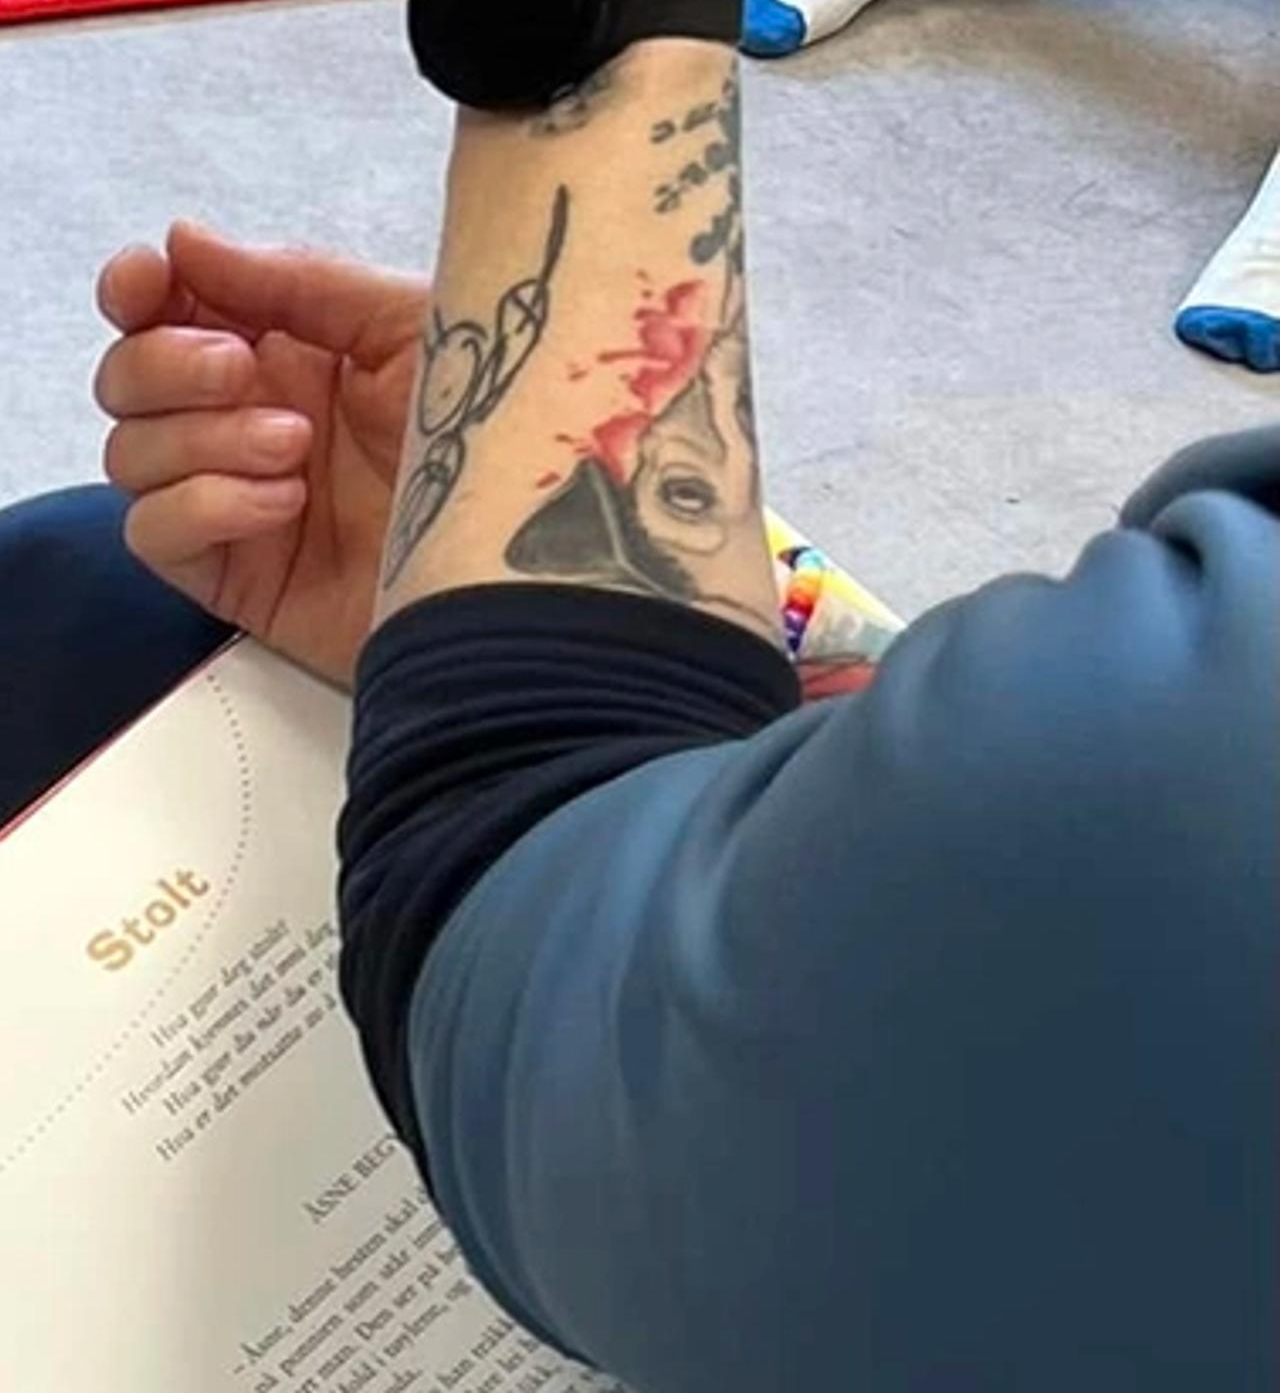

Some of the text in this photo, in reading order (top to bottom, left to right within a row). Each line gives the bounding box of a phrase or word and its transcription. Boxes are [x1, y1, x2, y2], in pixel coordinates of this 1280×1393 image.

[86, 868, 210, 972] Stolt
[121, 1050, 193, 1114] Hvordan
[250, 972, 276, 1000] det
[151, 1013, 188, 1047] Hva
[162, 1082, 201, 1115] Hva
[307, 968, 323, 987] er
[156, 1127, 195, 1161] Hva
[196, 1109, 212, 1130] er
[212, 1083, 240, 1112] det
[303, 1172, 360, 1224] ÅSNE
[279, 1314, 344, 1377] ponnien
[343, 1281, 380, 1313] som
[379, 1248, 411, 1280] står
[406, 1221, 442, 1251] inn
[288, 1278, 336, 1323] denne
[329, 1232, 387, 1282] hesten
[383, 1196, 419, 1234] skal
[354, 1308, 394, 1341] Den
[393, 1285, 418, 1309] ser
[417, 1262, 441, 1292] på
[383, 1304, 449, 1358] tøylene,
[436, 1358, 476, 1390] han
[471, 1317, 514, 1359] tråkk
